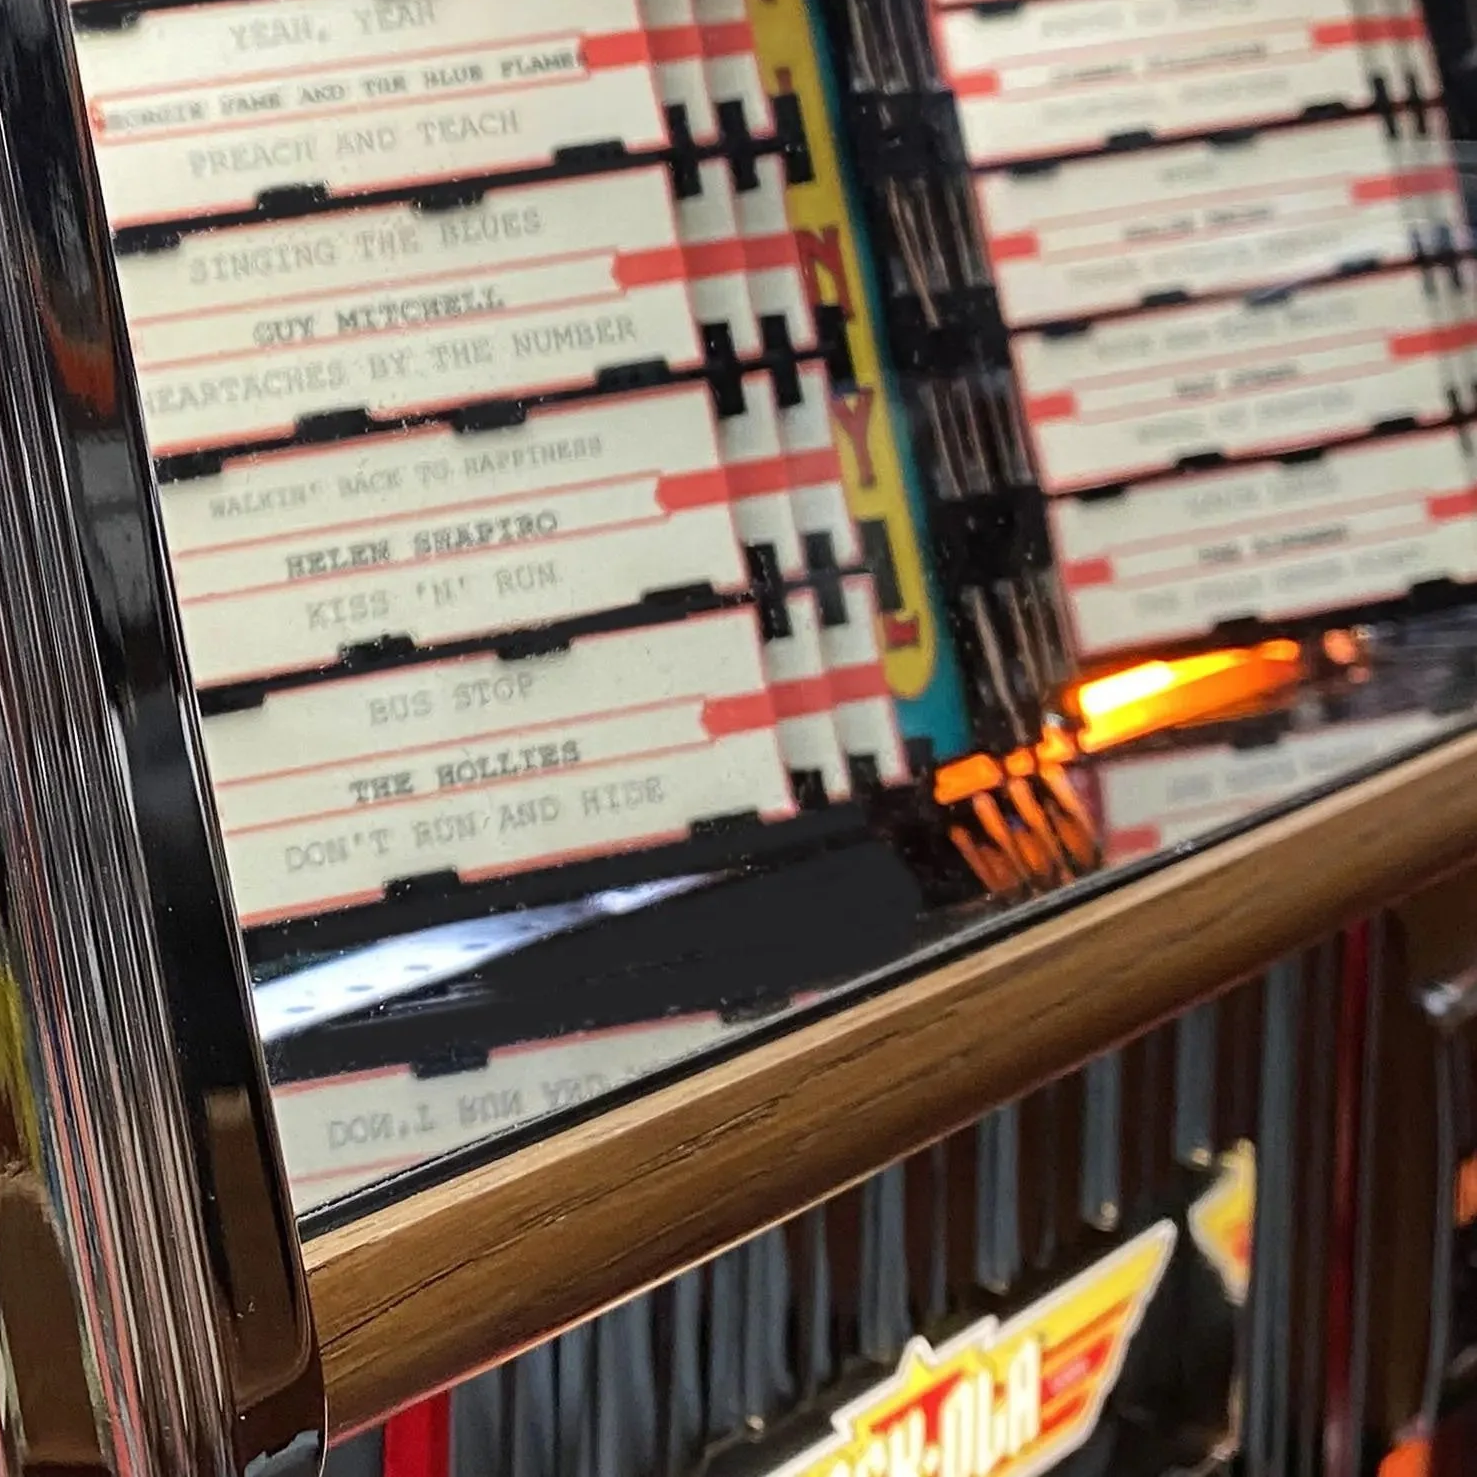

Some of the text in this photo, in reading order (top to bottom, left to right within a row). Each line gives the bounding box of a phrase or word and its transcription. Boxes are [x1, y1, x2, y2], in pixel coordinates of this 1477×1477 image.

[297, 83, 346, 106] AND
[188, 109, 521, 178] PREACH AND TEACH
[188, 205, 544, 284] SINGING THE BLUES
[252, 283, 507, 349] GUY MITCHELL
[368, 348, 410, 382] BY
[431, 336, 495, 372] THE
[511, 311, 639, 359] NUMBER
[337, 470, 405, 499] BACK
[463, 434, 604, 477] HAPPINESS
[285, 508, 560, 580] HELEN SHAPIRO
[305, 558, 559, 631] KISS 'N' RUN
[368, 671, 538, 727] BUS STOP
[348, 739, 582, 805] THE HOLLIES
[284, 776, 667, 874] DON'T RUN AND HIDE
